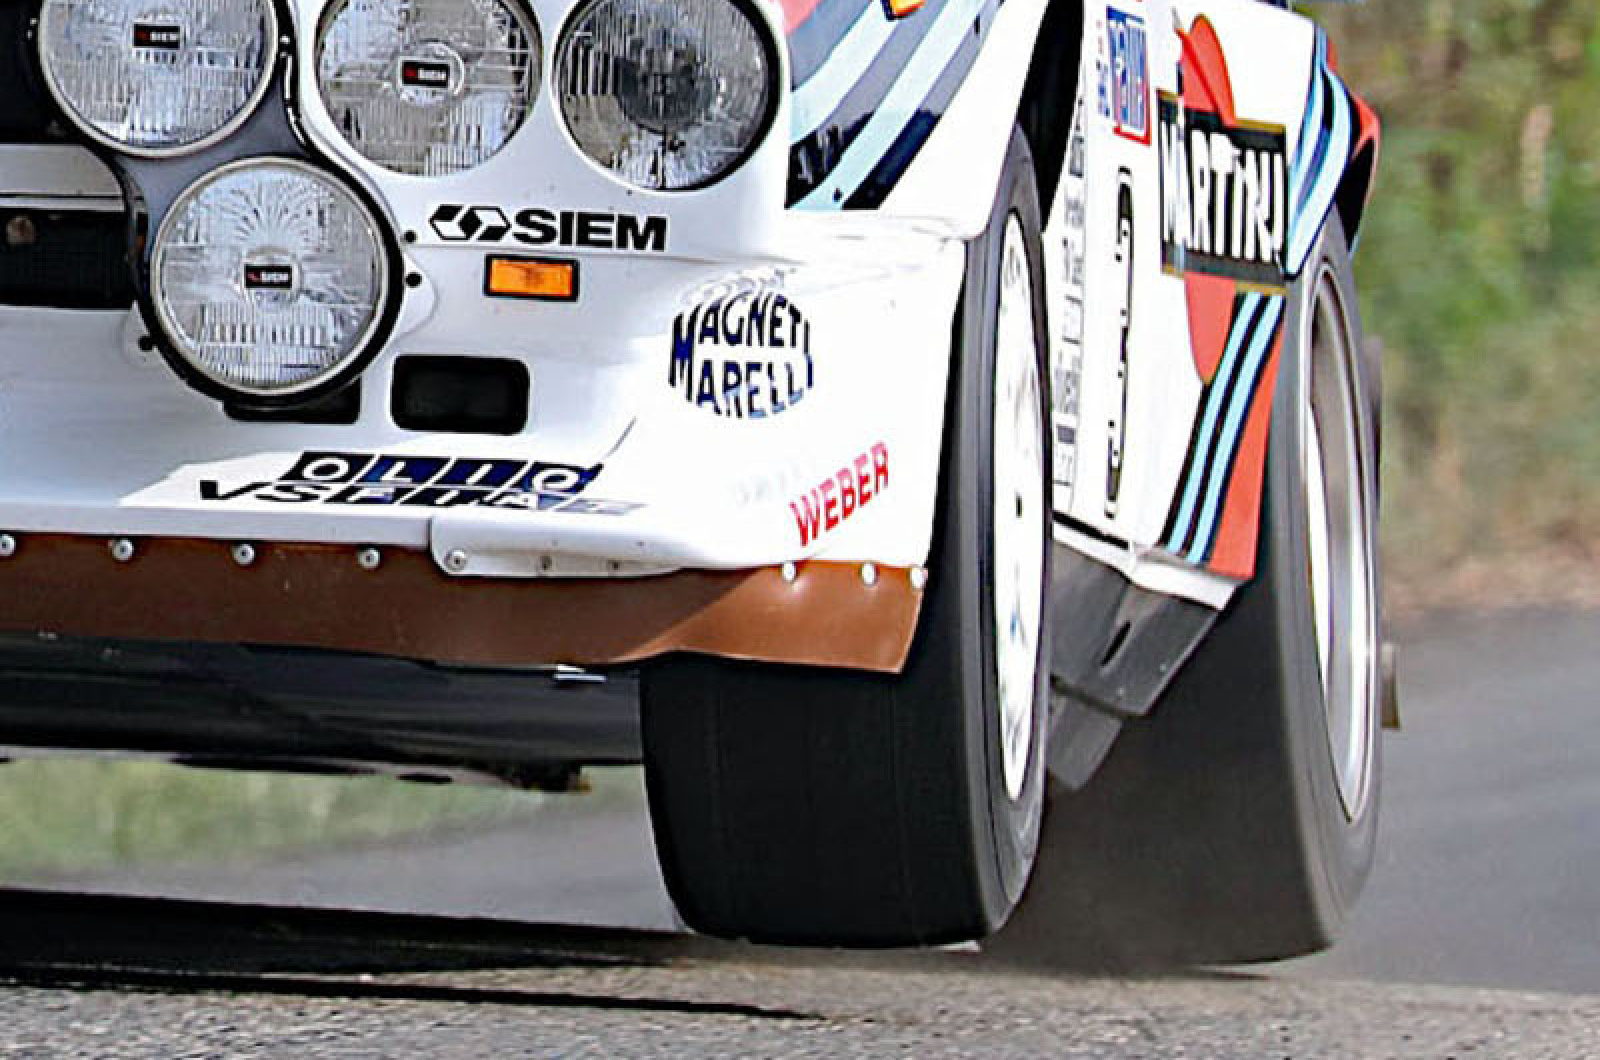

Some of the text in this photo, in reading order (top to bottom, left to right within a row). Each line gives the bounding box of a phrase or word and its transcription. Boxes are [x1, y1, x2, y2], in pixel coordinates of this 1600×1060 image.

[513, 209, 667, 251] SIEM
[670, 292, 810, 358] MAGNETI
[668, 356, 814, 419] MARELLI
[301, 456, 582, 492] OLIO
[789, 441, 890, 548] WEBER
